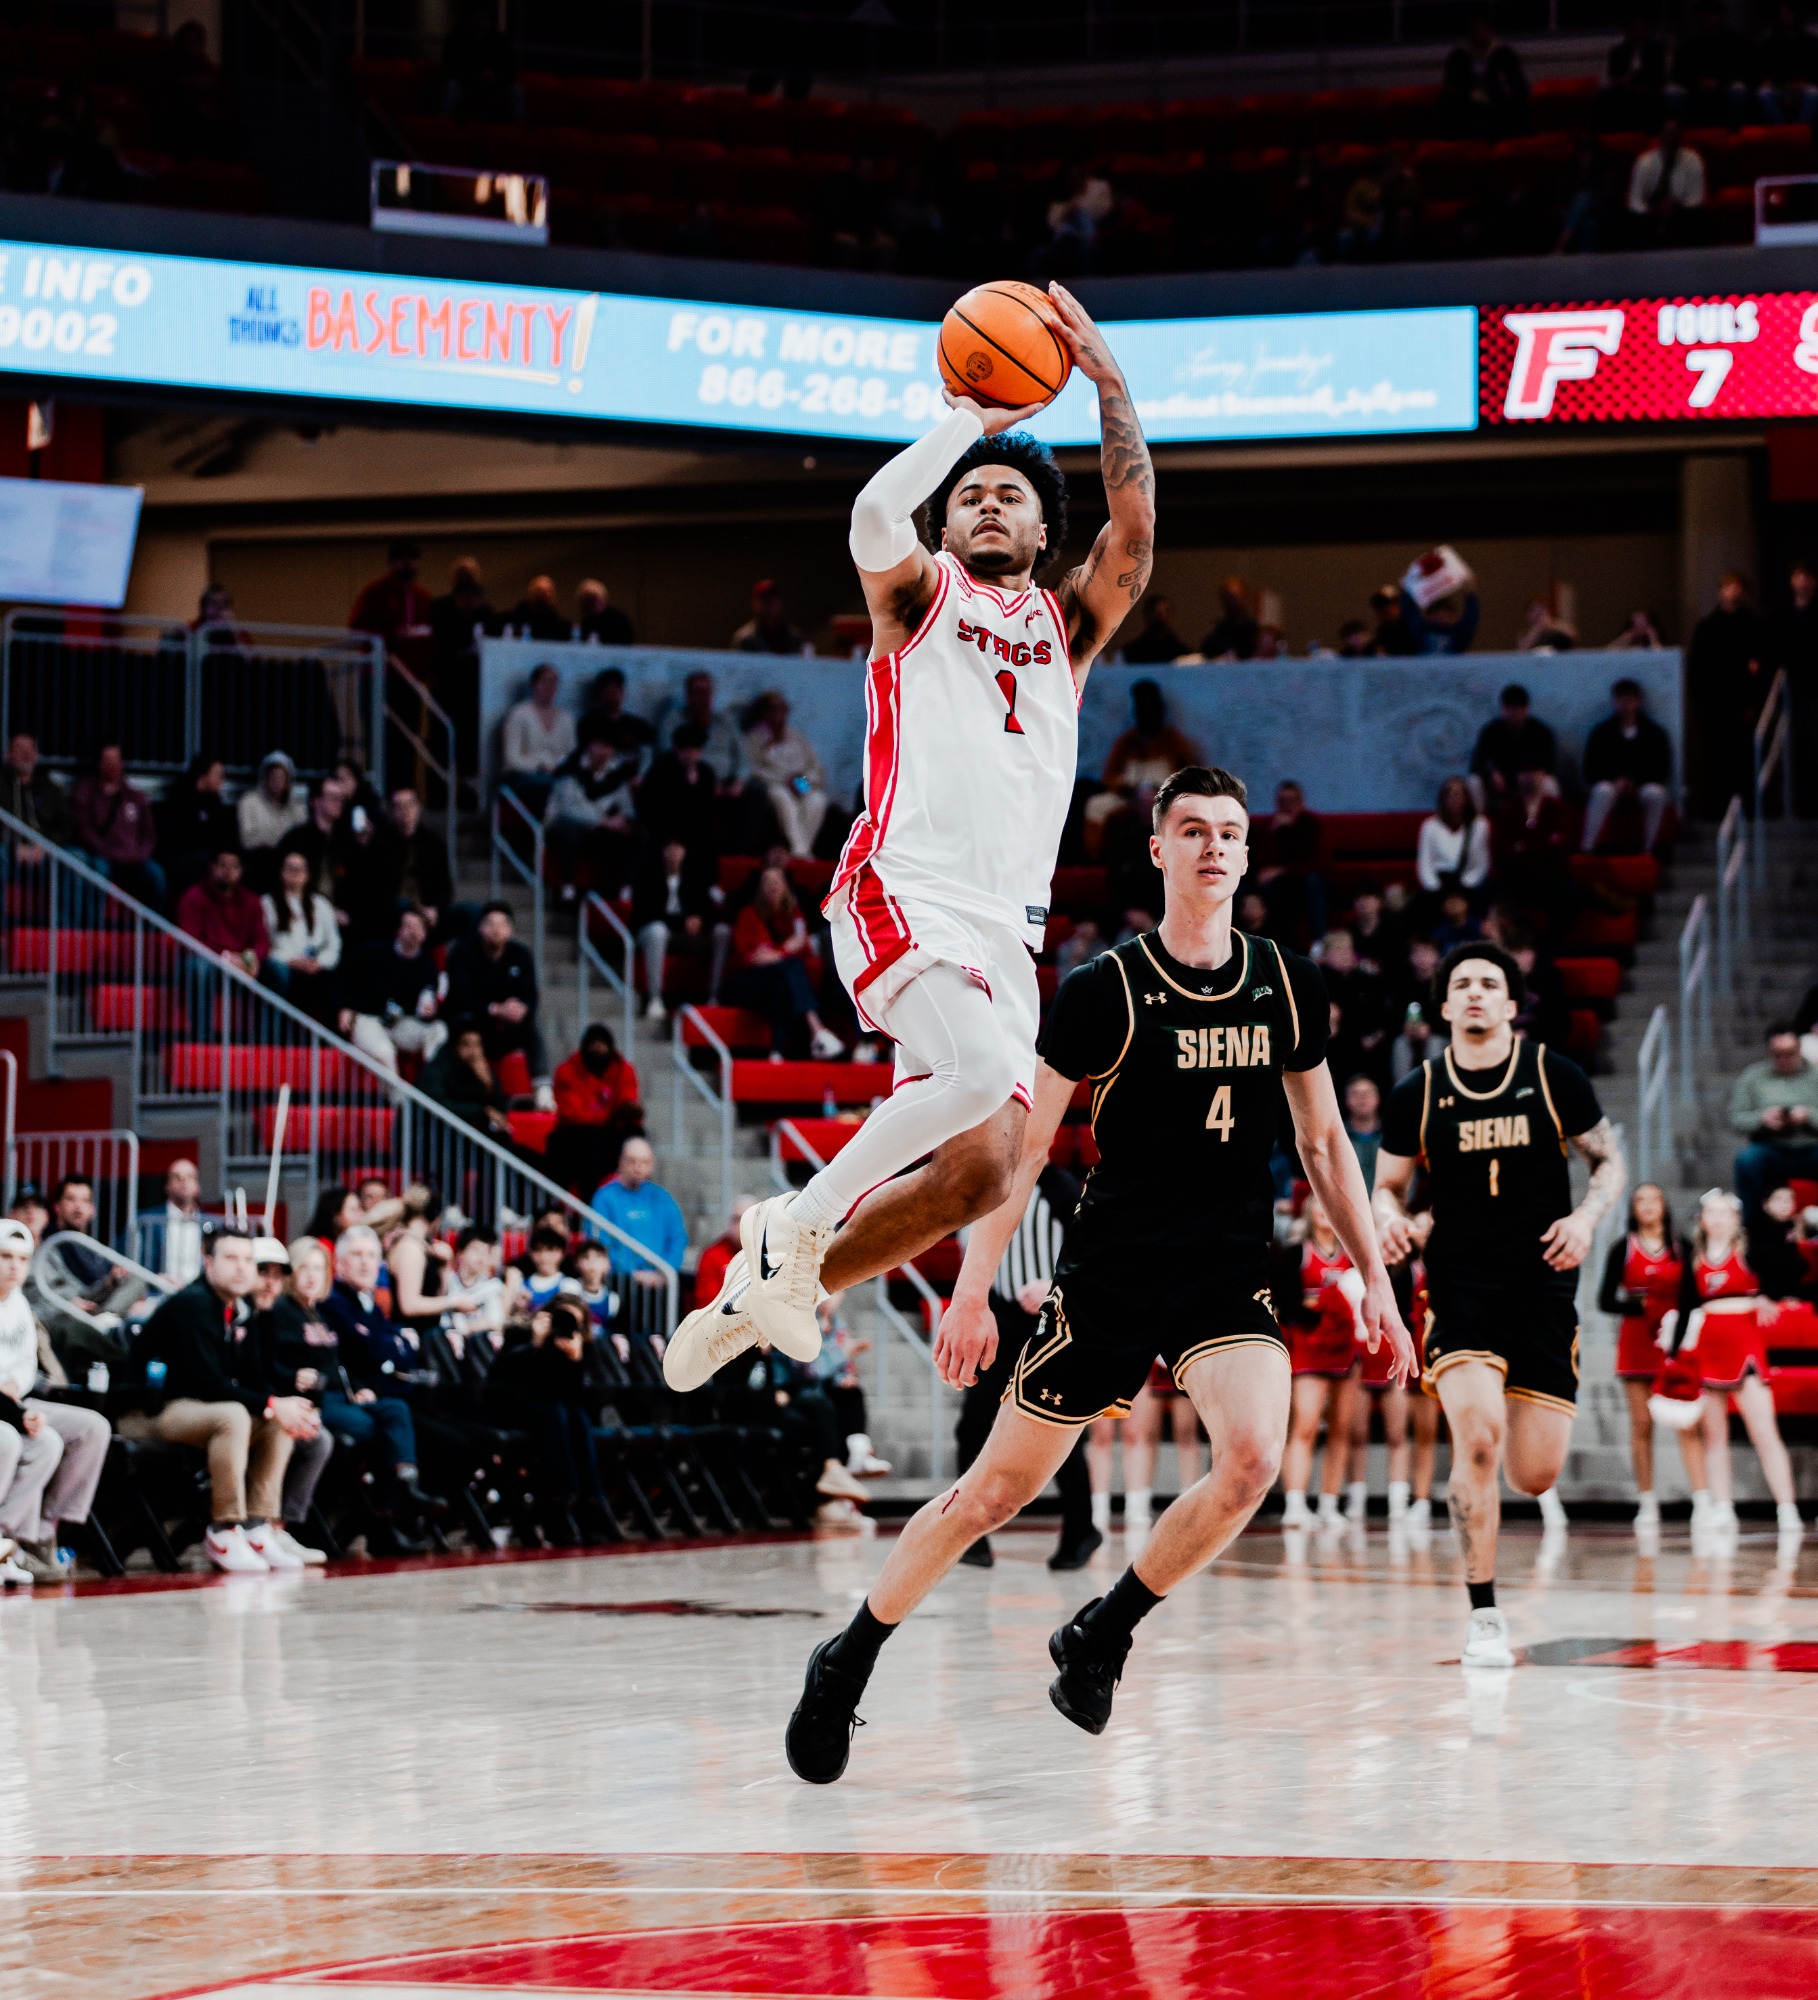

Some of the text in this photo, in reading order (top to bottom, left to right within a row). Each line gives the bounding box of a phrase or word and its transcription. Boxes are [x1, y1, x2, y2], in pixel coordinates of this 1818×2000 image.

[24, 255, 153, 308] INFO
[306, 287, 598, 394] BASEMENTY!
[667, 312, 767, 360] FOR
[778, 322, 920, 374] MORE
[1657, 300, 1760, 346] FOULS
[1685, 348, 1734, 409] 7
[957, 618, 1051, 666] STAGS
[996, 669, 1025, 735] 1
[1174, 1025, 1271, 1069] SIENA
[1205, 1085, 1235, 1142] 4
[1458, 1114, 1531, 1152] SIENA
[1489, 1158, 1500, 1197] 1
